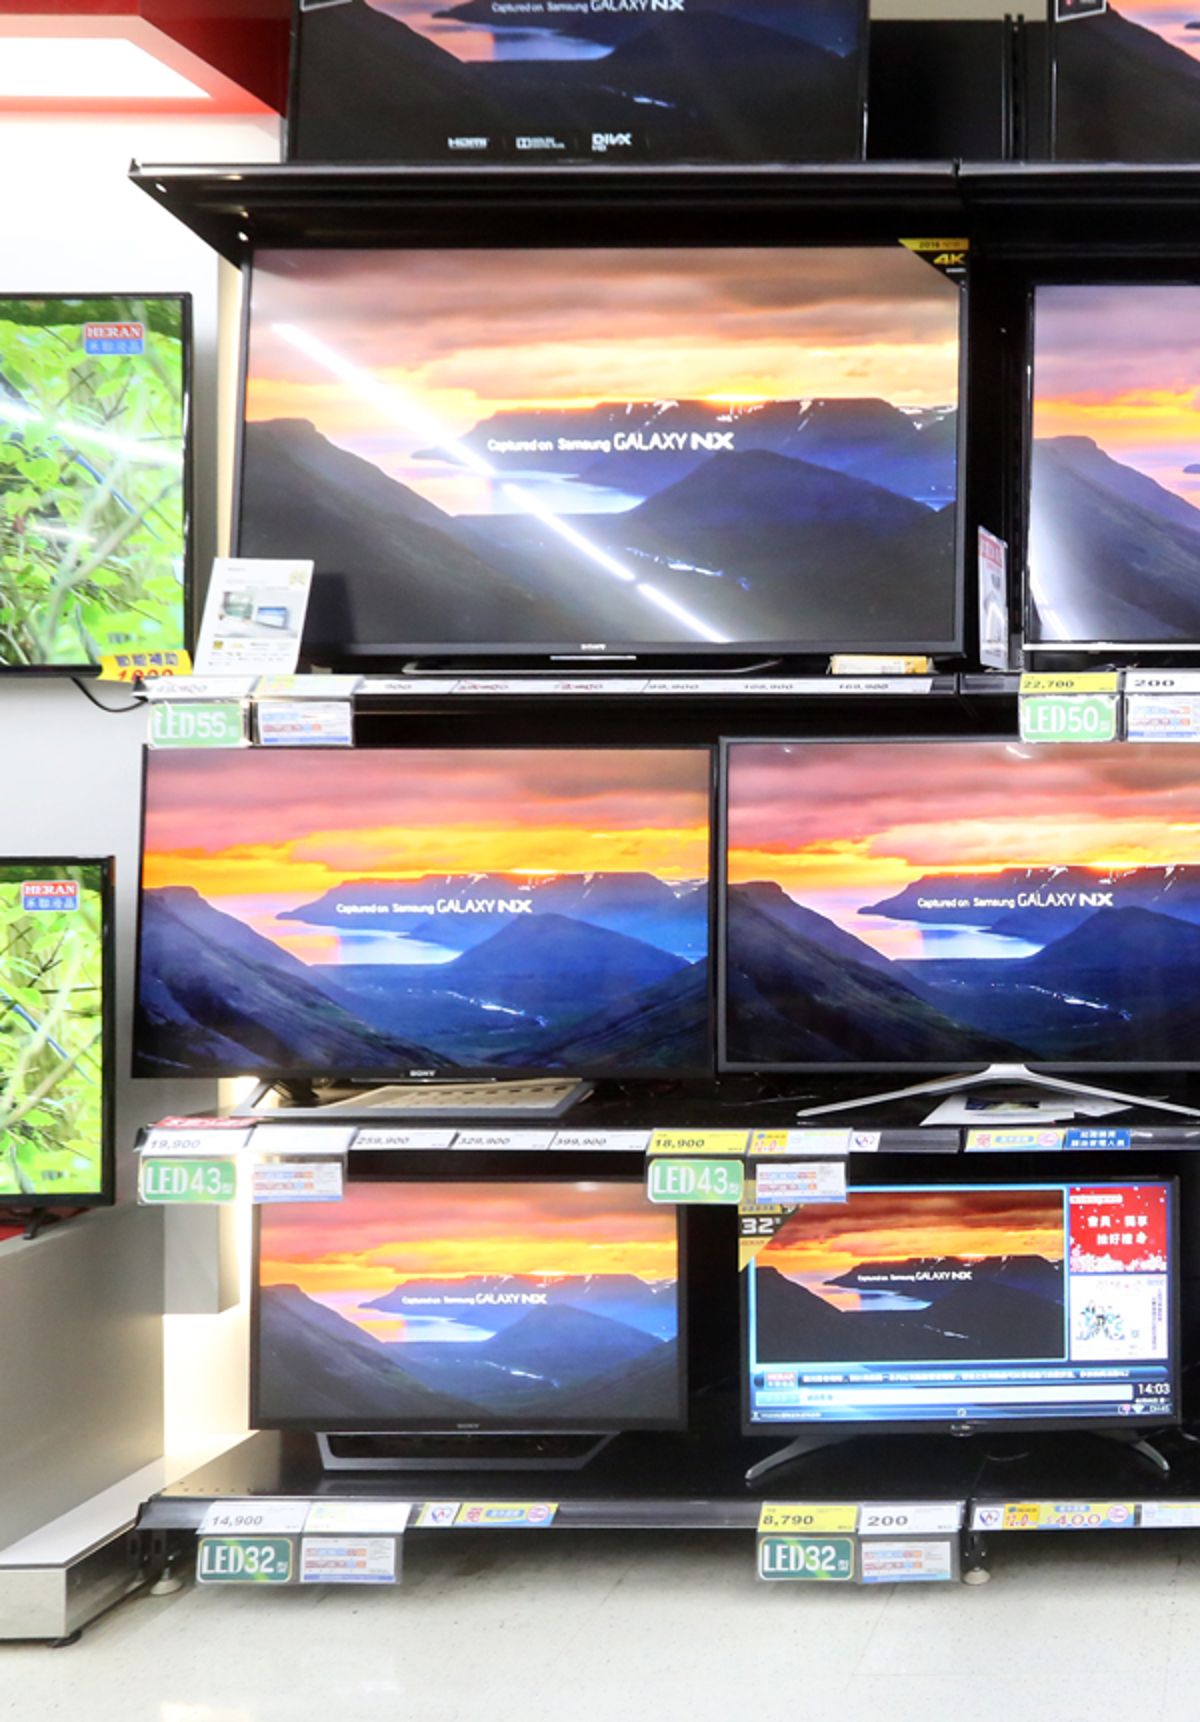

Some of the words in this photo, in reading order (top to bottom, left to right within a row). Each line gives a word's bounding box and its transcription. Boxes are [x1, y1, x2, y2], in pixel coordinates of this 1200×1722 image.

[547, 3, 588, 13] Samsung
[592, 0, 648, 11] GALAXY
[652, 0, 685, 11] NX
[448, 138, 488, 148] HDMI
[934, 253, 966, 265] 4K
[87, 327, 141, 338] HERAN
[487, 439, 536, 452] Captured
[558, 438, 611, 452] Samsung
[613, 432, 688, 451] GALAXY
[691, 432, 735, 450] NX
[1024, 680, 1075, 690] 22,700
[1134, 679, 1175, 688] 200
[1024, 704, 1099, 734] LED50
[24, 884, 77, 895] HERAN
[917, 898, 956, 908] Captured
[973, 898, 1015, 909] Samsung
[1017, 892, 1076, 908] GALAXY
[1079, 893, 1114, 907] NX
[336, 904, 376, 914] Captured
[392, 904, 434, 914] Samsung
[436, 899, 495, 914] GALAXY
[498, 900, 533, 914] NX
[655, 1138, 705, 1148] 18,900
[146, 1167, 221, 1194] LED43
[654, 1166, 728, 1196] LED43
[916, 1272, 950, 1280] GALAXY
[476, 1293, 520, 1304] GALAXY
[1138, 1384, 1170, 1394] 14:03
[212, 1516, 263, 1526] 14,900
[763, 1516, 814, 1526] 8,790
[867, 1516, 908, 1526] 200
[202, 1546, 276, 1574] LED32
[764, 1544, 836, 1572] LED32
